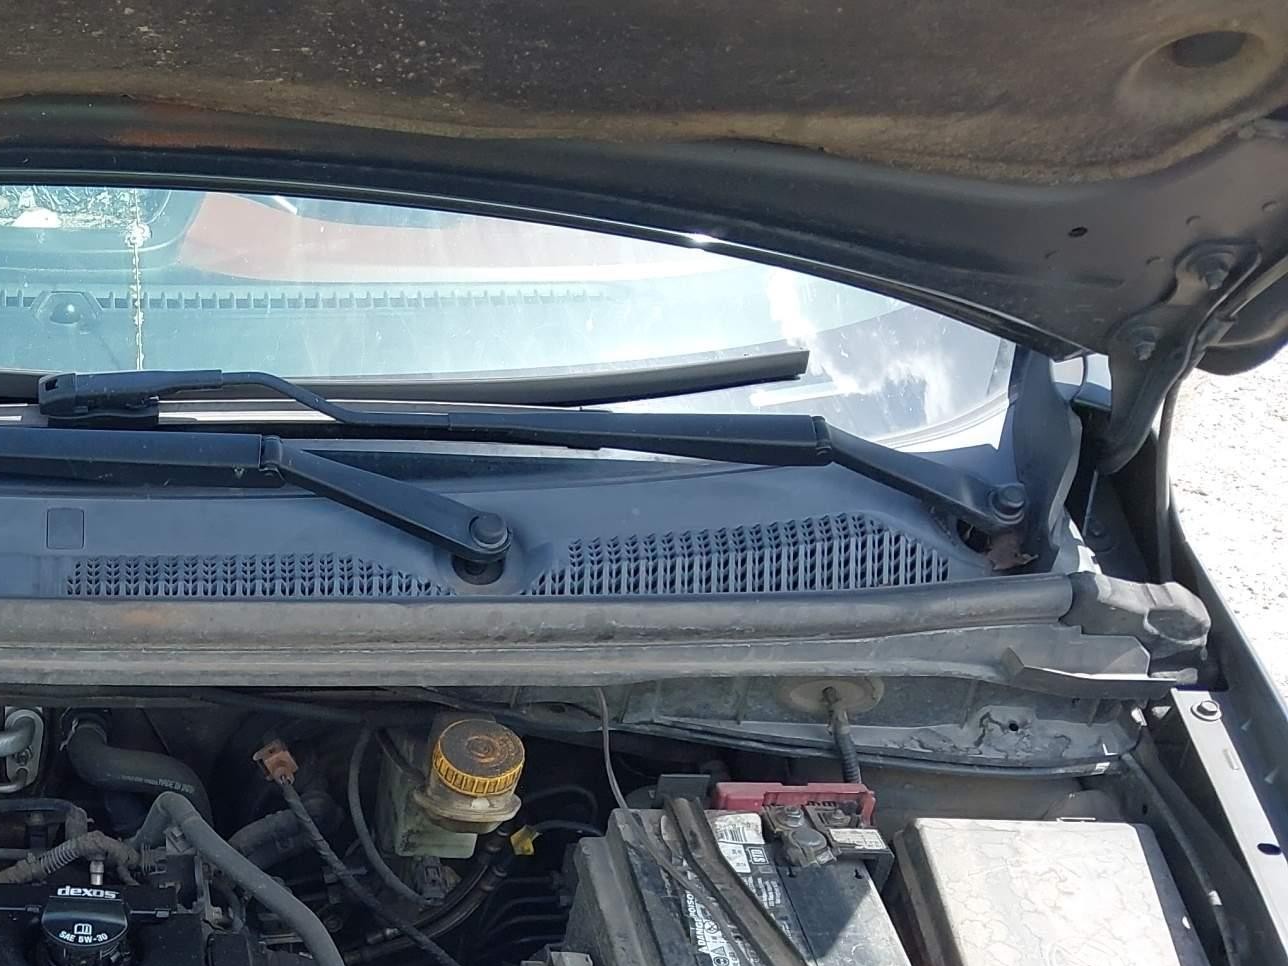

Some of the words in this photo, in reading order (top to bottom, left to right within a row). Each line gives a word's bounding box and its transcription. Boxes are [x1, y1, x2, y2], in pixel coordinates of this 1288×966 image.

[57, 885, 120, 899] dexos
[59, 930, 76, 942] SAE
[78, 933, 108, 943] 5W-30
